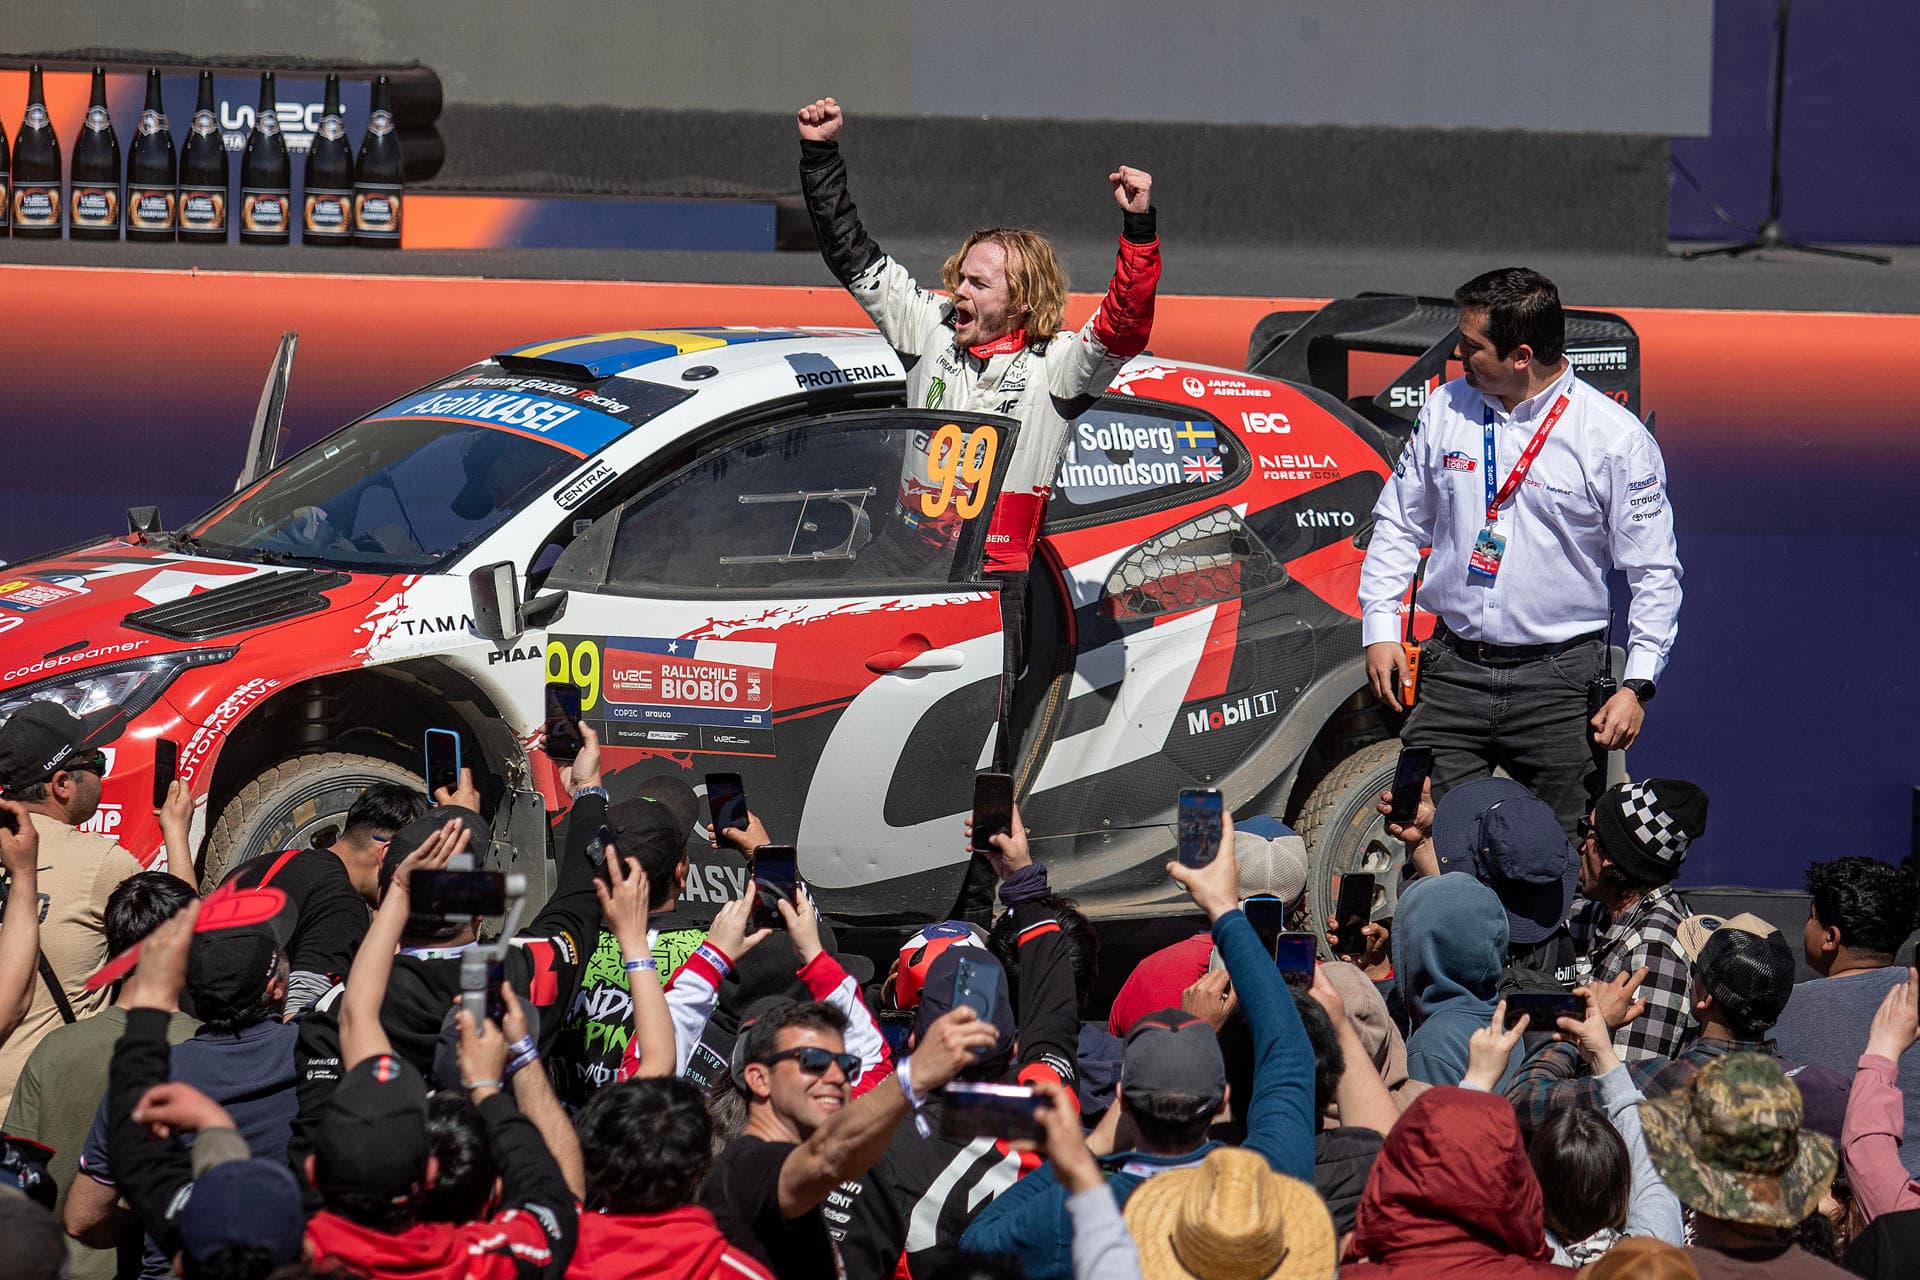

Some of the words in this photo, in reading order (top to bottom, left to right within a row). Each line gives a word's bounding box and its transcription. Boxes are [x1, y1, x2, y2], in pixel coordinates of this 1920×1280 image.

[795, 363, 896, 389] PROTERIAL
[1207, 379, 1247, 388] JAPAN
[519, 379, 578, 396] GAZOO
[571, 389, 630, 414] Racing
[1213, 388, 1272, 398] AIRLINES
[1390, 379, 1431, 408] Stil
[401, 392, 582, 432] AsahiKASEI
[1078, 422, 1175, 455] Solberg
[556, 463, 613, 508] CENTRAL
[920, 423, 999, 521] 99
[1056, 457, 1180, 488] dmondson
[1630, 492, 1661, 506] arauco
[986, 535, 1010, 543] BERG
[401, 614, 476, 636] TAMA
[4, 640, 149, 681] codebeamer
[488, 646, 543, 665] PIAA
[612, 669, 652, 682] WRC
[661, 664, 738, 682] RALLYCHILE
[661, 679, 738, 703] BIOBÍO
[178, 677, 265, 772] nasonic
[645, 710, 672, 719] arauco
[1187, 697, 1251, 735] Mobil
[181, 679, 281, 781] UTOMOTIVE
[44, 744, 73, 771] WRC
[80, 810, 121, 833] MP
[677, 865, 746, 904] ASY
